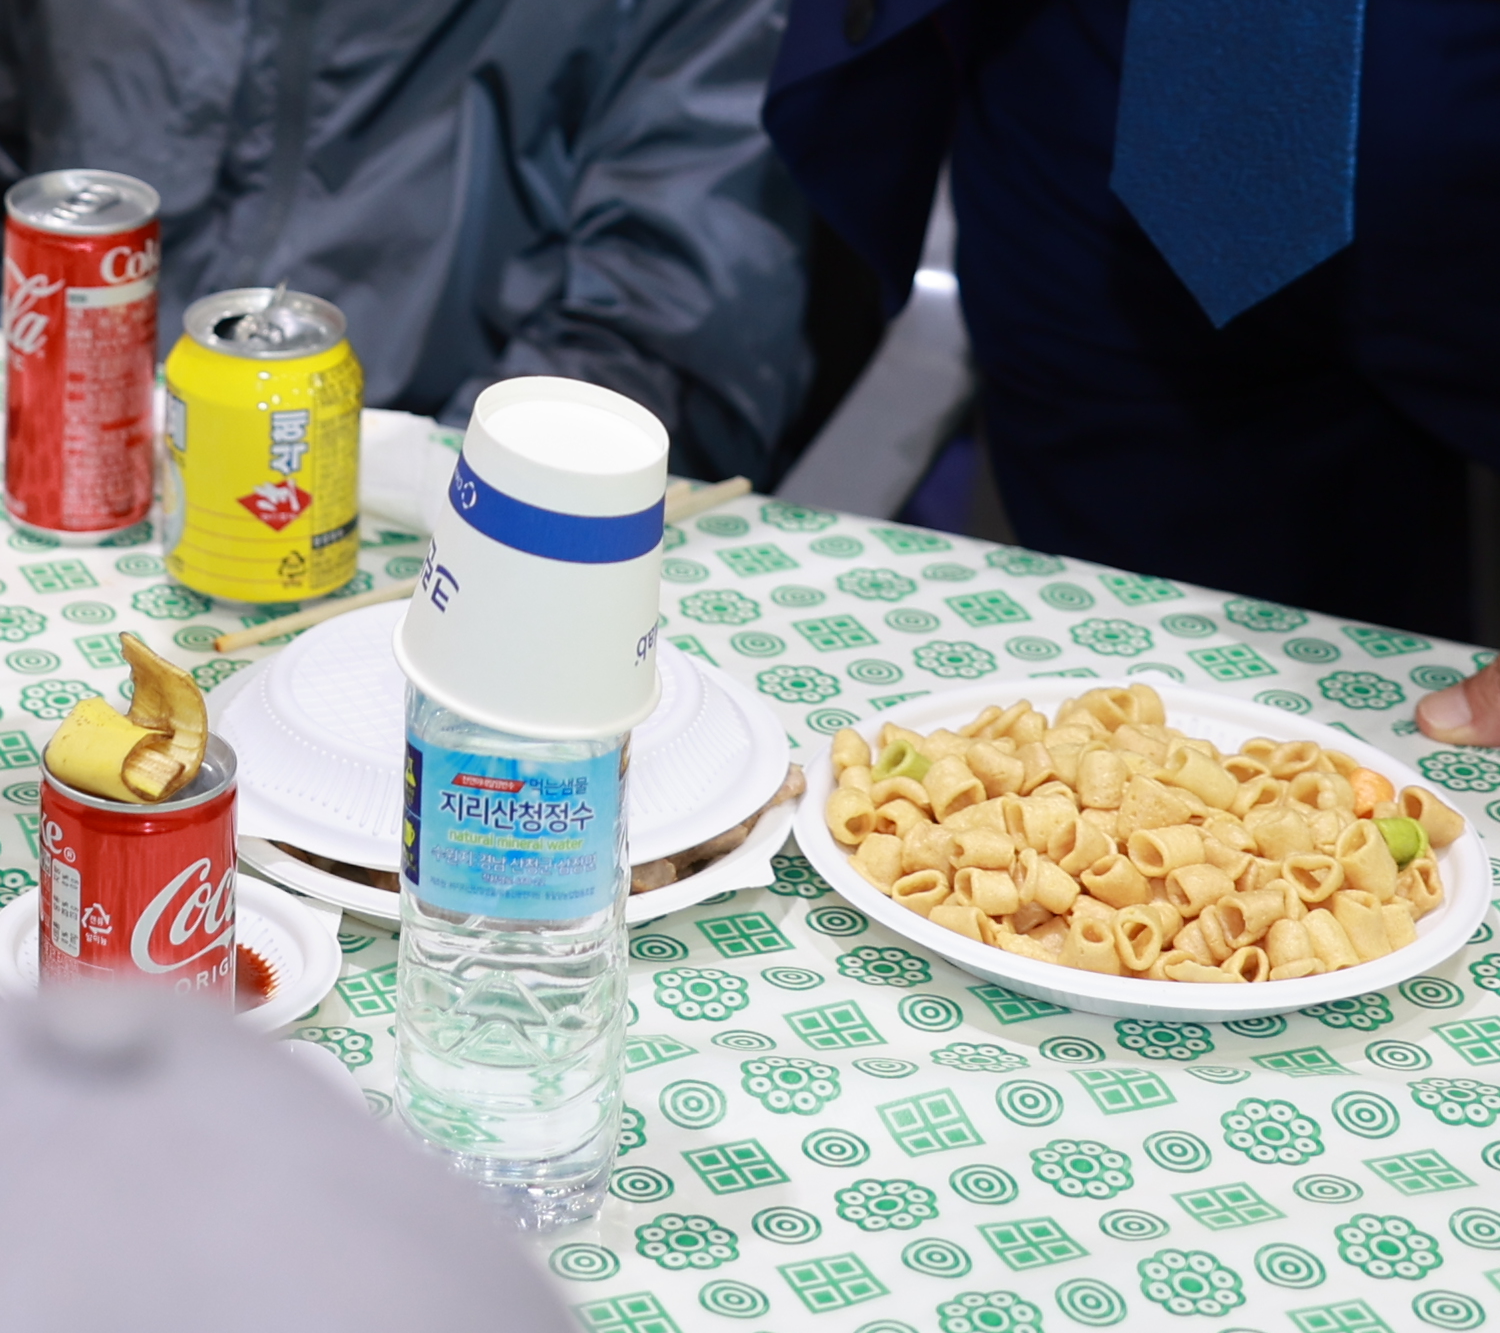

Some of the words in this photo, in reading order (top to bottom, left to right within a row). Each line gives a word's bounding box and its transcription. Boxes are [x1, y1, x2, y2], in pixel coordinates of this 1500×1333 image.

[529, 777, 589, 796] 먹는샘물
[440, 791, 595, 833] 지리산청정수
[448, 830, 494, 847] natural
[498, 834, 543, 850] mineral
[546, 838, 584, 851] water
